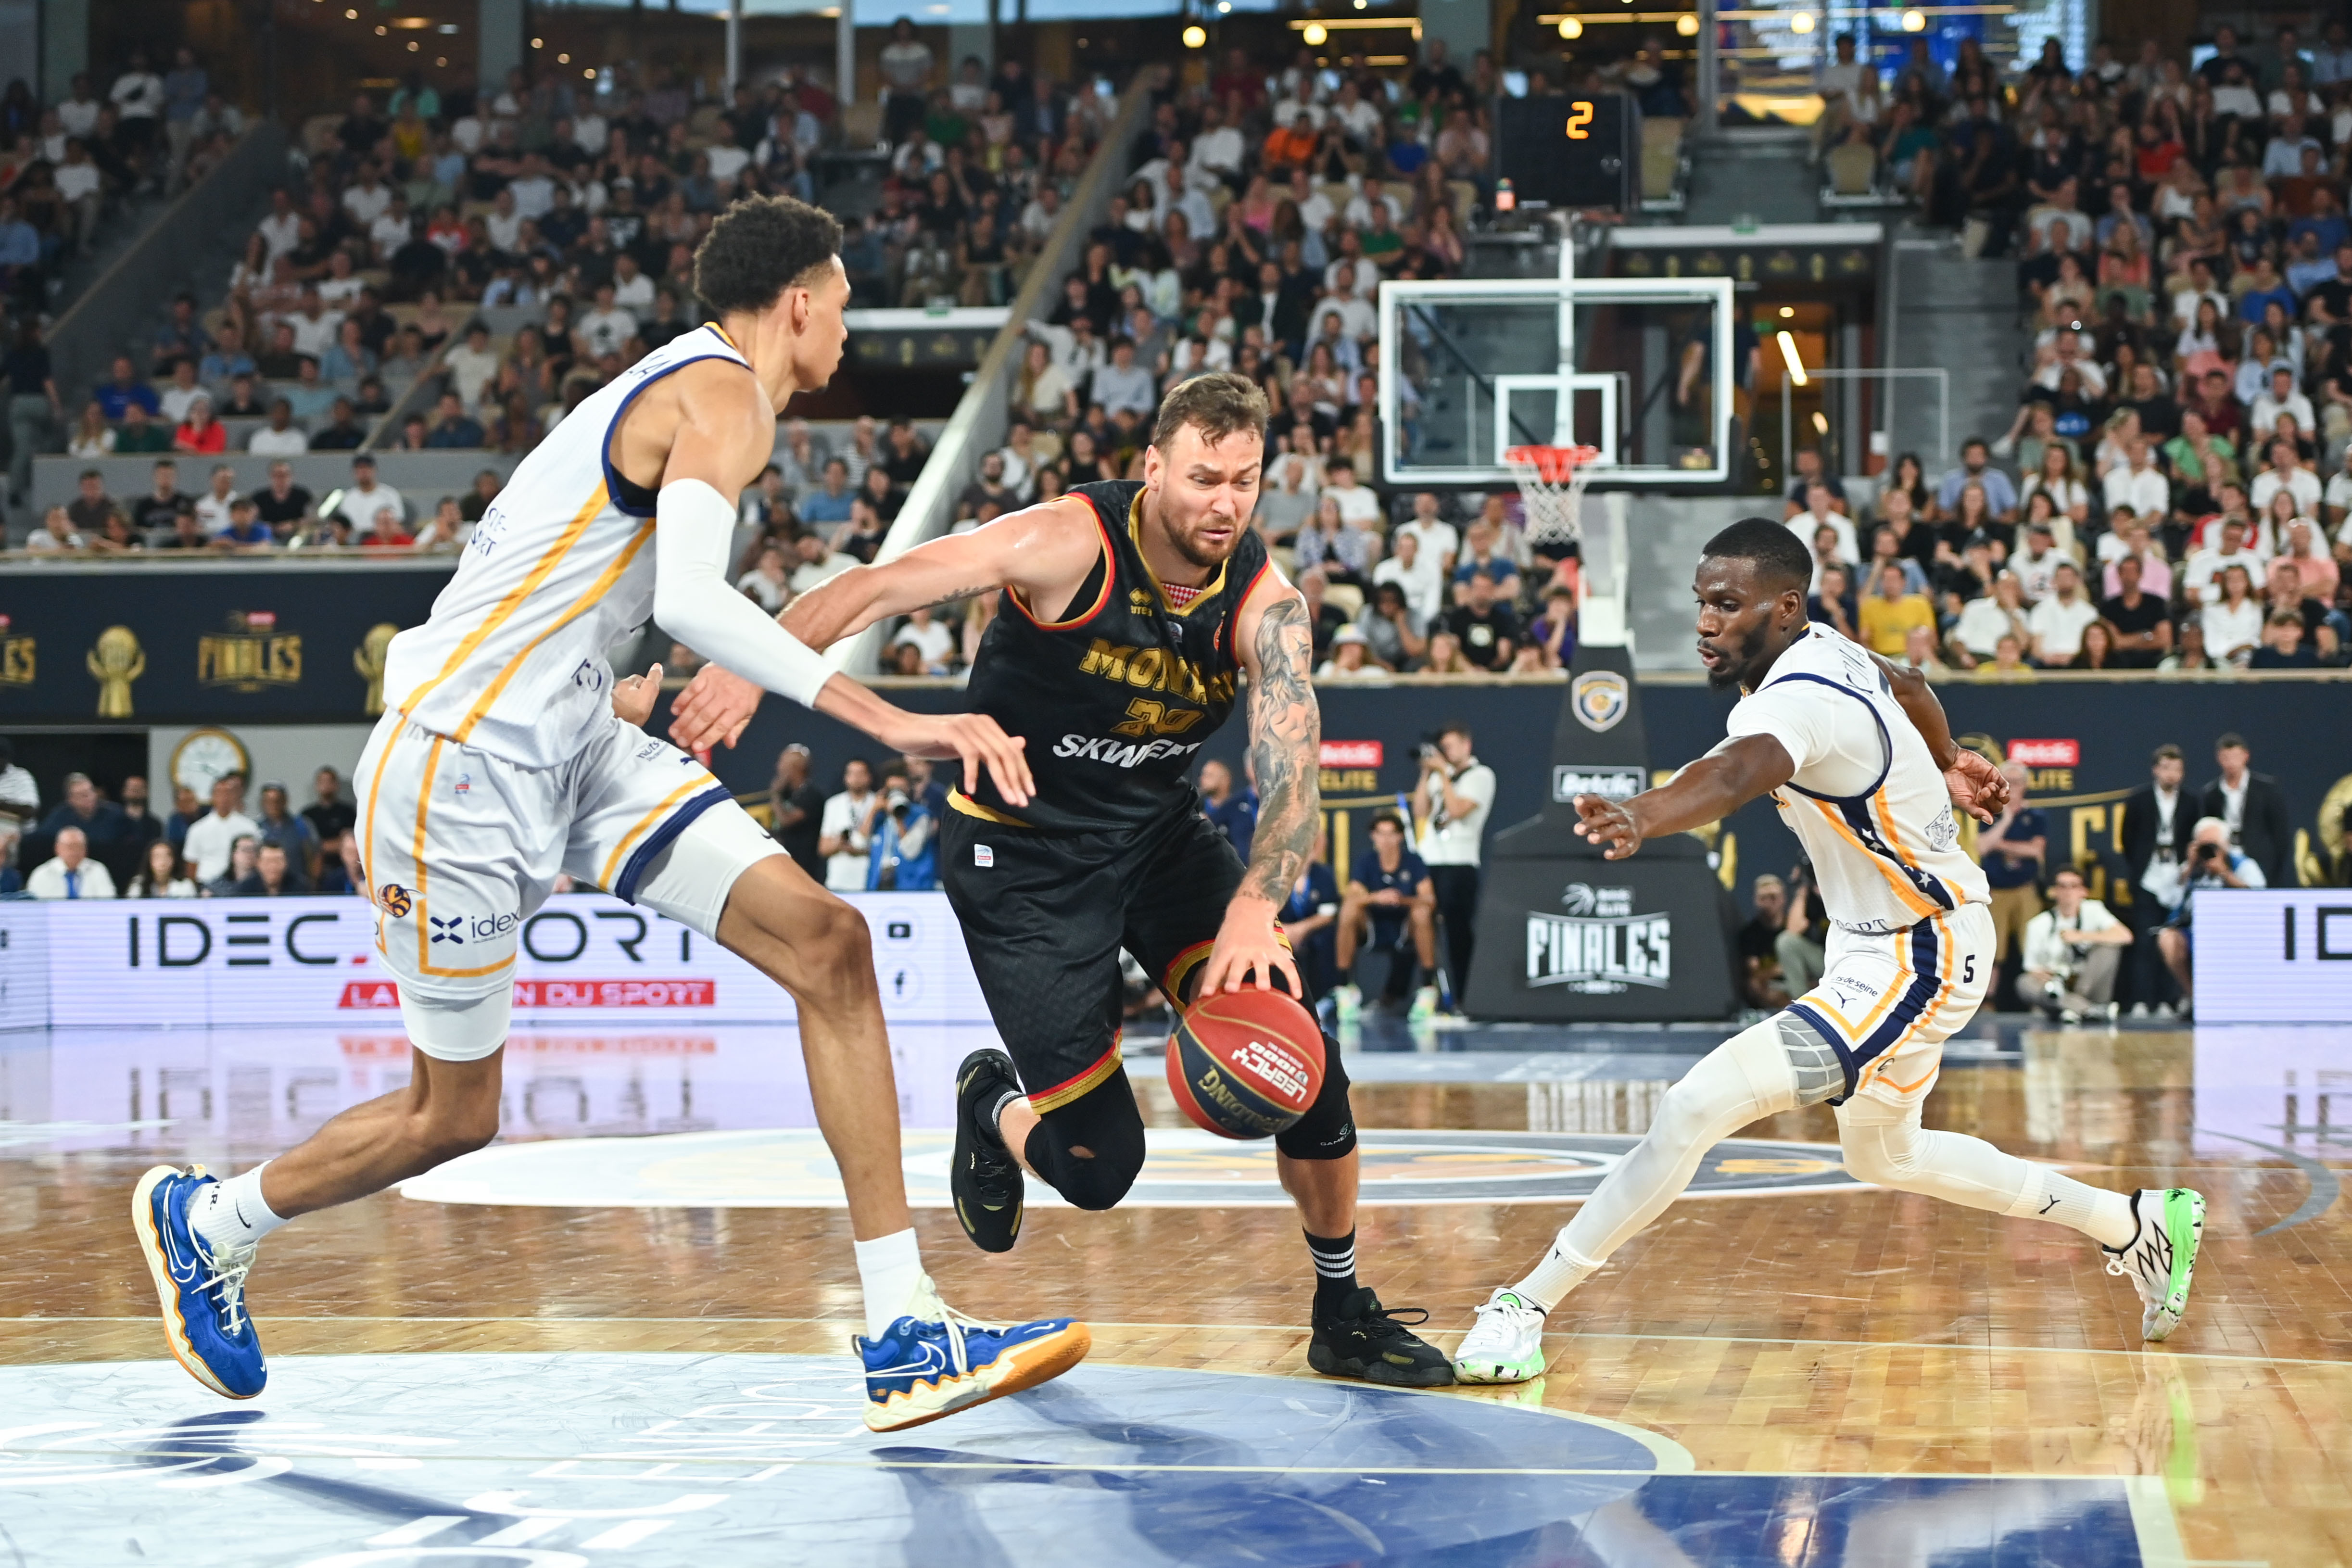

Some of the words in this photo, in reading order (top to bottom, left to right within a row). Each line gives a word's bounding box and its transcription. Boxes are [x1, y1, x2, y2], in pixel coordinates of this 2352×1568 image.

[1566, 101, 1593, 139] 2
[1110, 697, 1204, 737] 20
[2026, 769, 2074, 791] LITE
[129, 914, 339, 967] IDEC
[471, 905, 520, 939] idex
[523, 911, 690, 963] ORT
[1526, 917, 1670, 980] FINALES
[1963, 954, 1975, 984] 5
[351, 985, 395, 1006] LA
[546, 983, 593, 1005] DU
[600, 982, 708, 1005] SPORT
[1231, 1047, 1307, 1103] LEGACY
[1248, 1041, 1299, 1077] 1000
